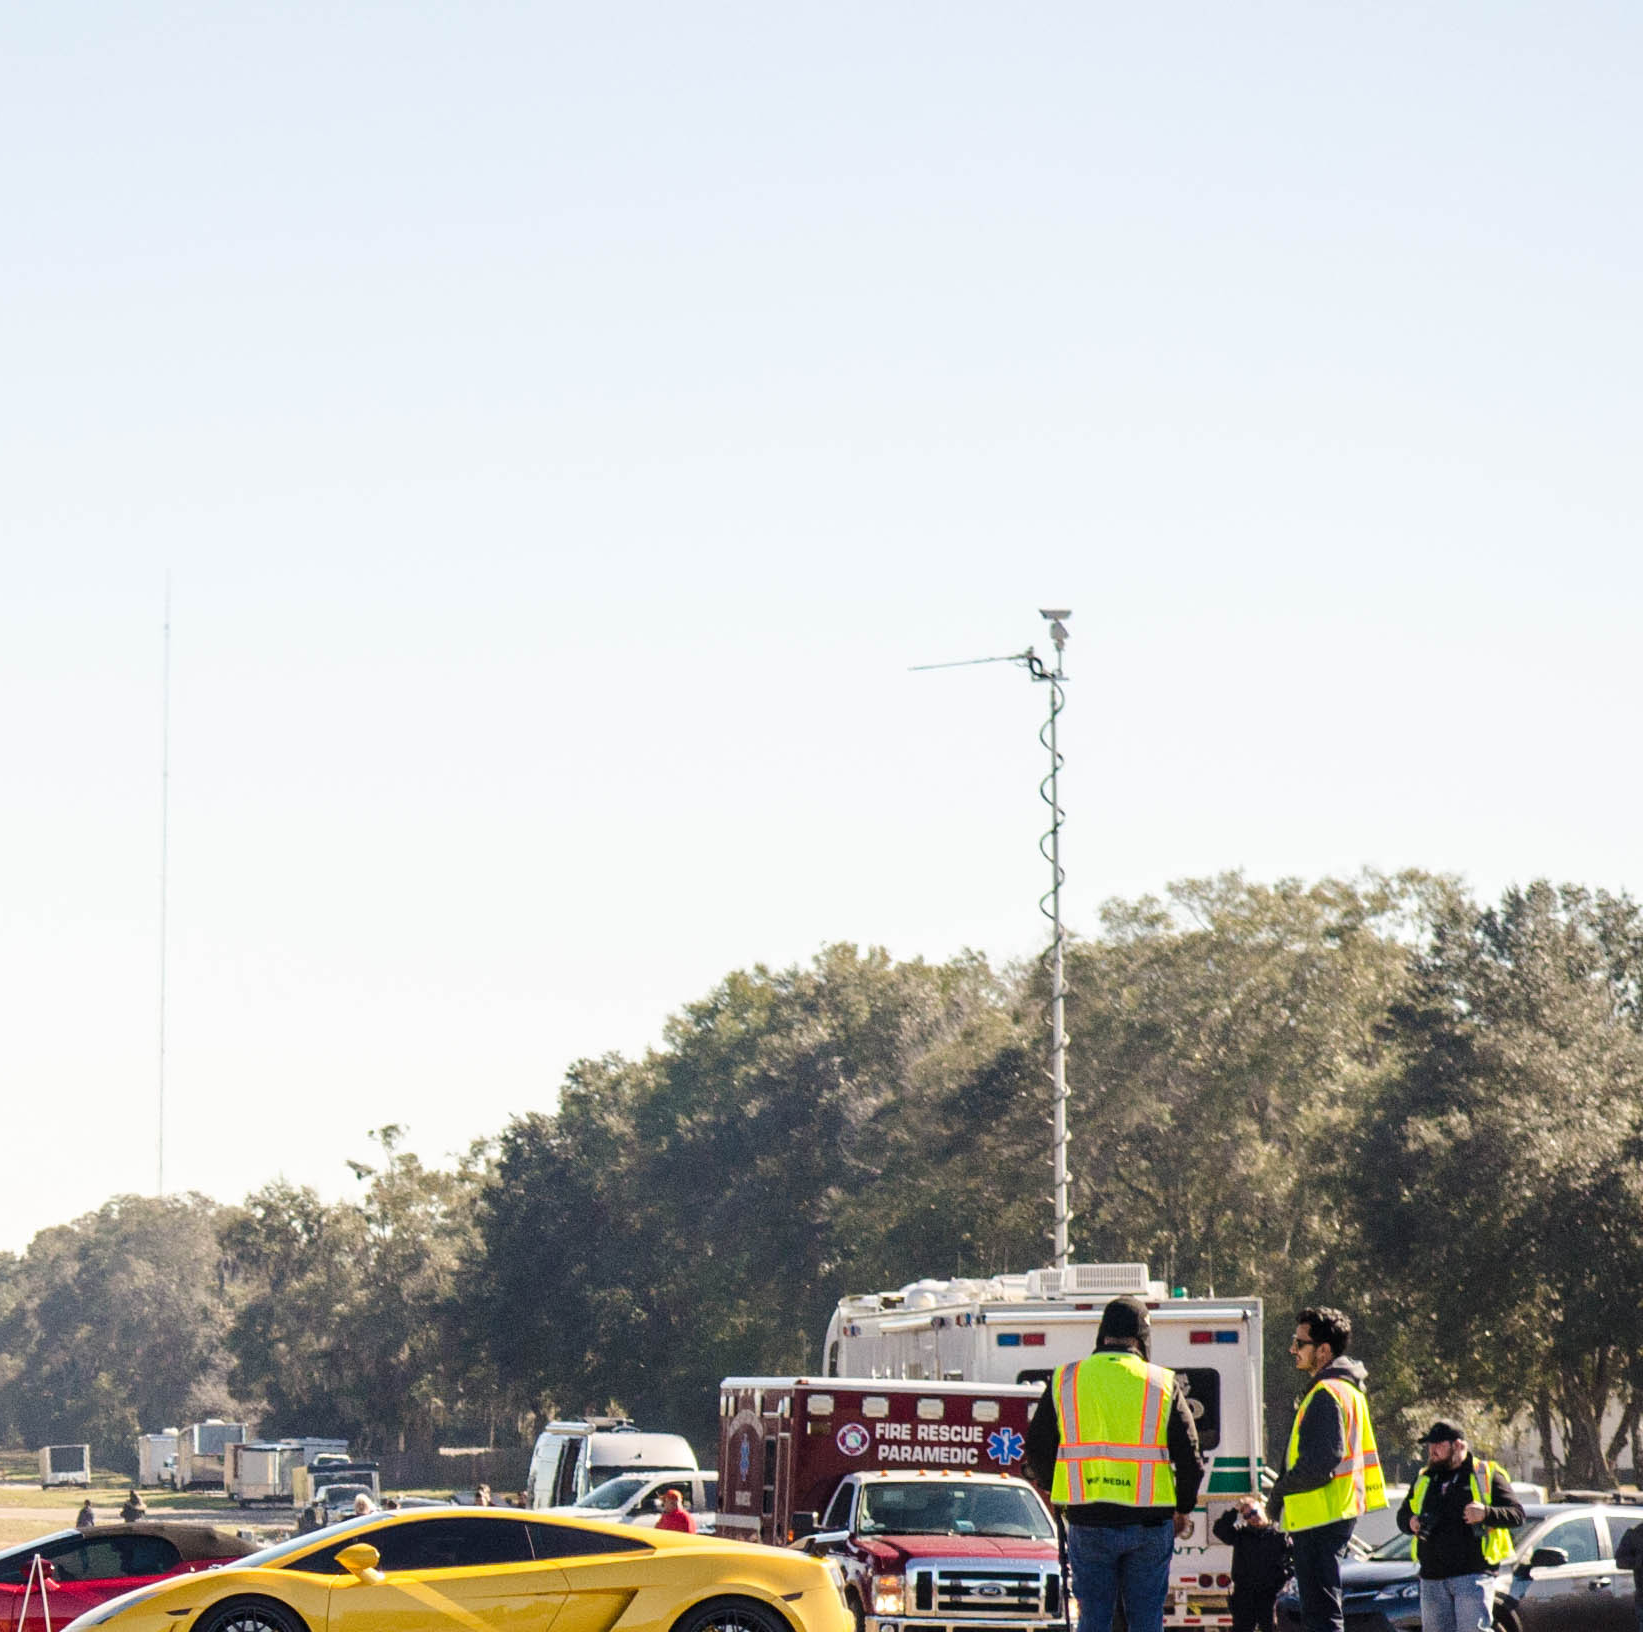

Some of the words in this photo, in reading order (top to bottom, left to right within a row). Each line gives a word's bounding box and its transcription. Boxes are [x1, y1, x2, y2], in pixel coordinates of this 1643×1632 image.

[875, 1423, 912, 1440] FIRE
[917, 1424, 984, 1443] RESCUE
[878, 1444, 979, 1465] PARAMEDIC
[1102, 1476, 1131, 1487] MEDIA
